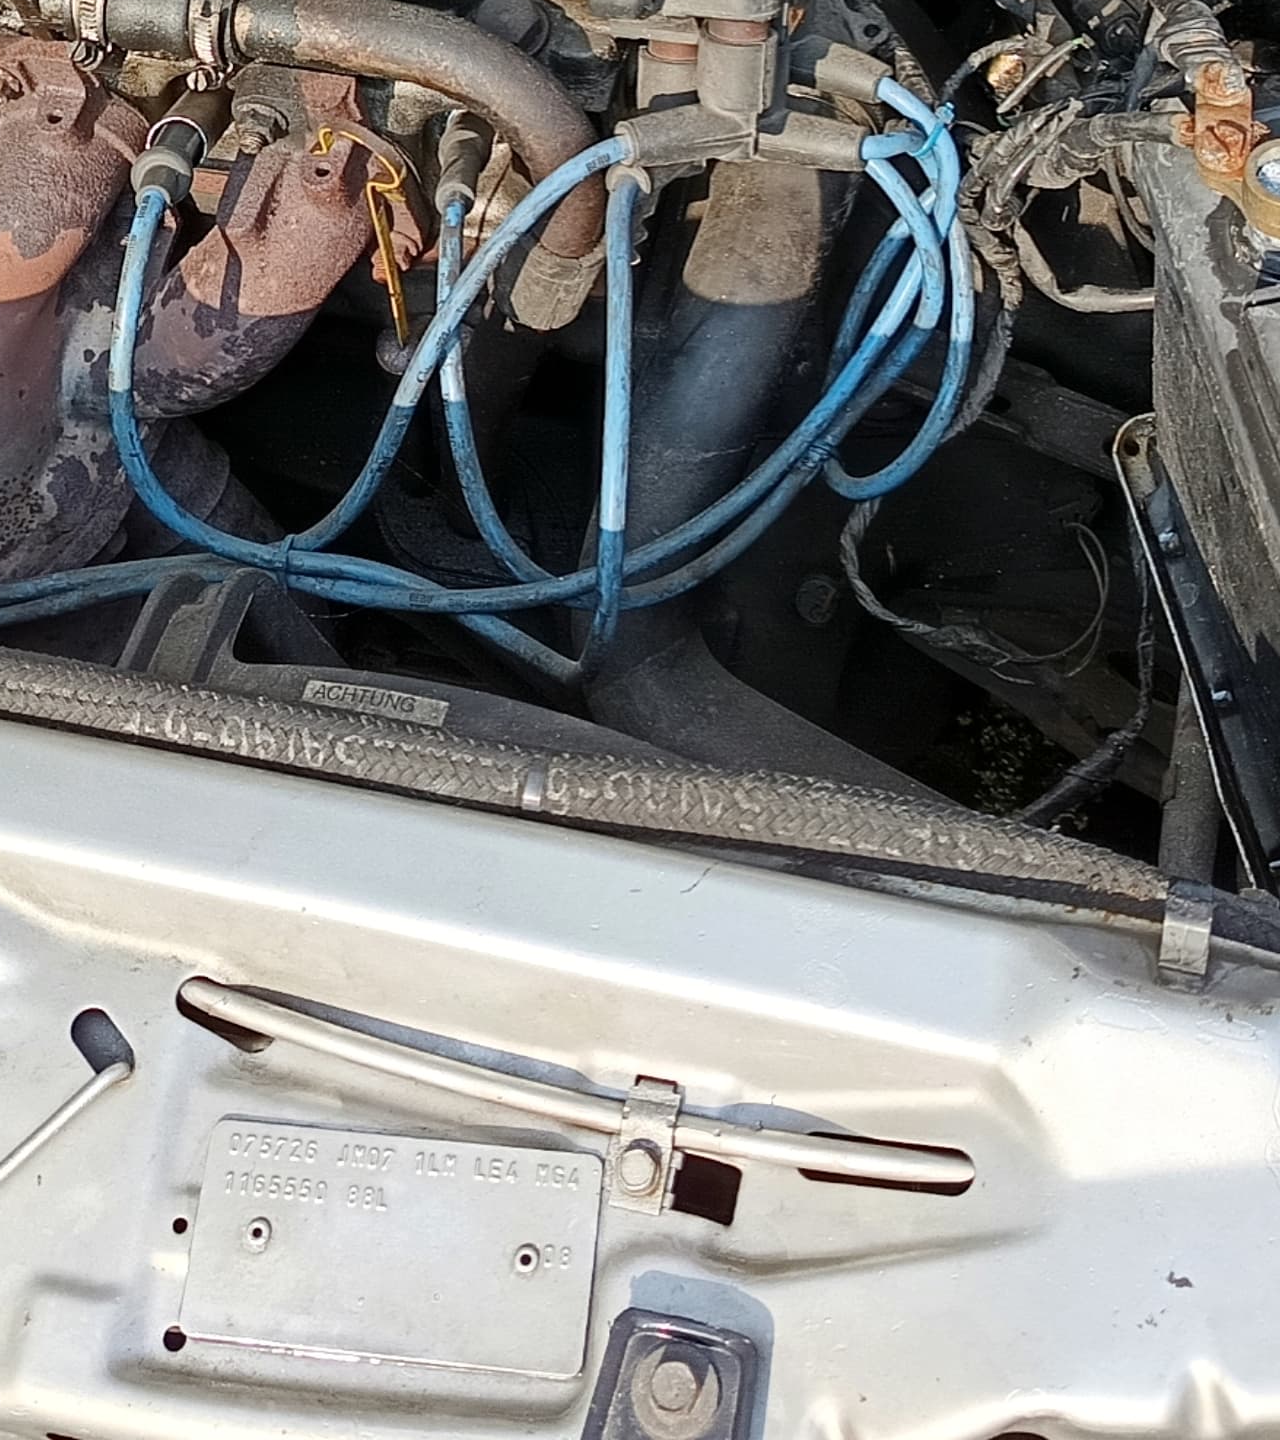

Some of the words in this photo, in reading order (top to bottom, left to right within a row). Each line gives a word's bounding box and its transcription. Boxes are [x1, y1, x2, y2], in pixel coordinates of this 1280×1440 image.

[312, 683, 418, 714] ACHTUNG
[228, 1132, 320, 1164] 075726
[414, 1151, 457, 1178] 1LM
[473, 1156, 520, 1185] LE4
[224, 1170, 329, 1205] 1165550
[346, 1184, 389, 1212] 88L
